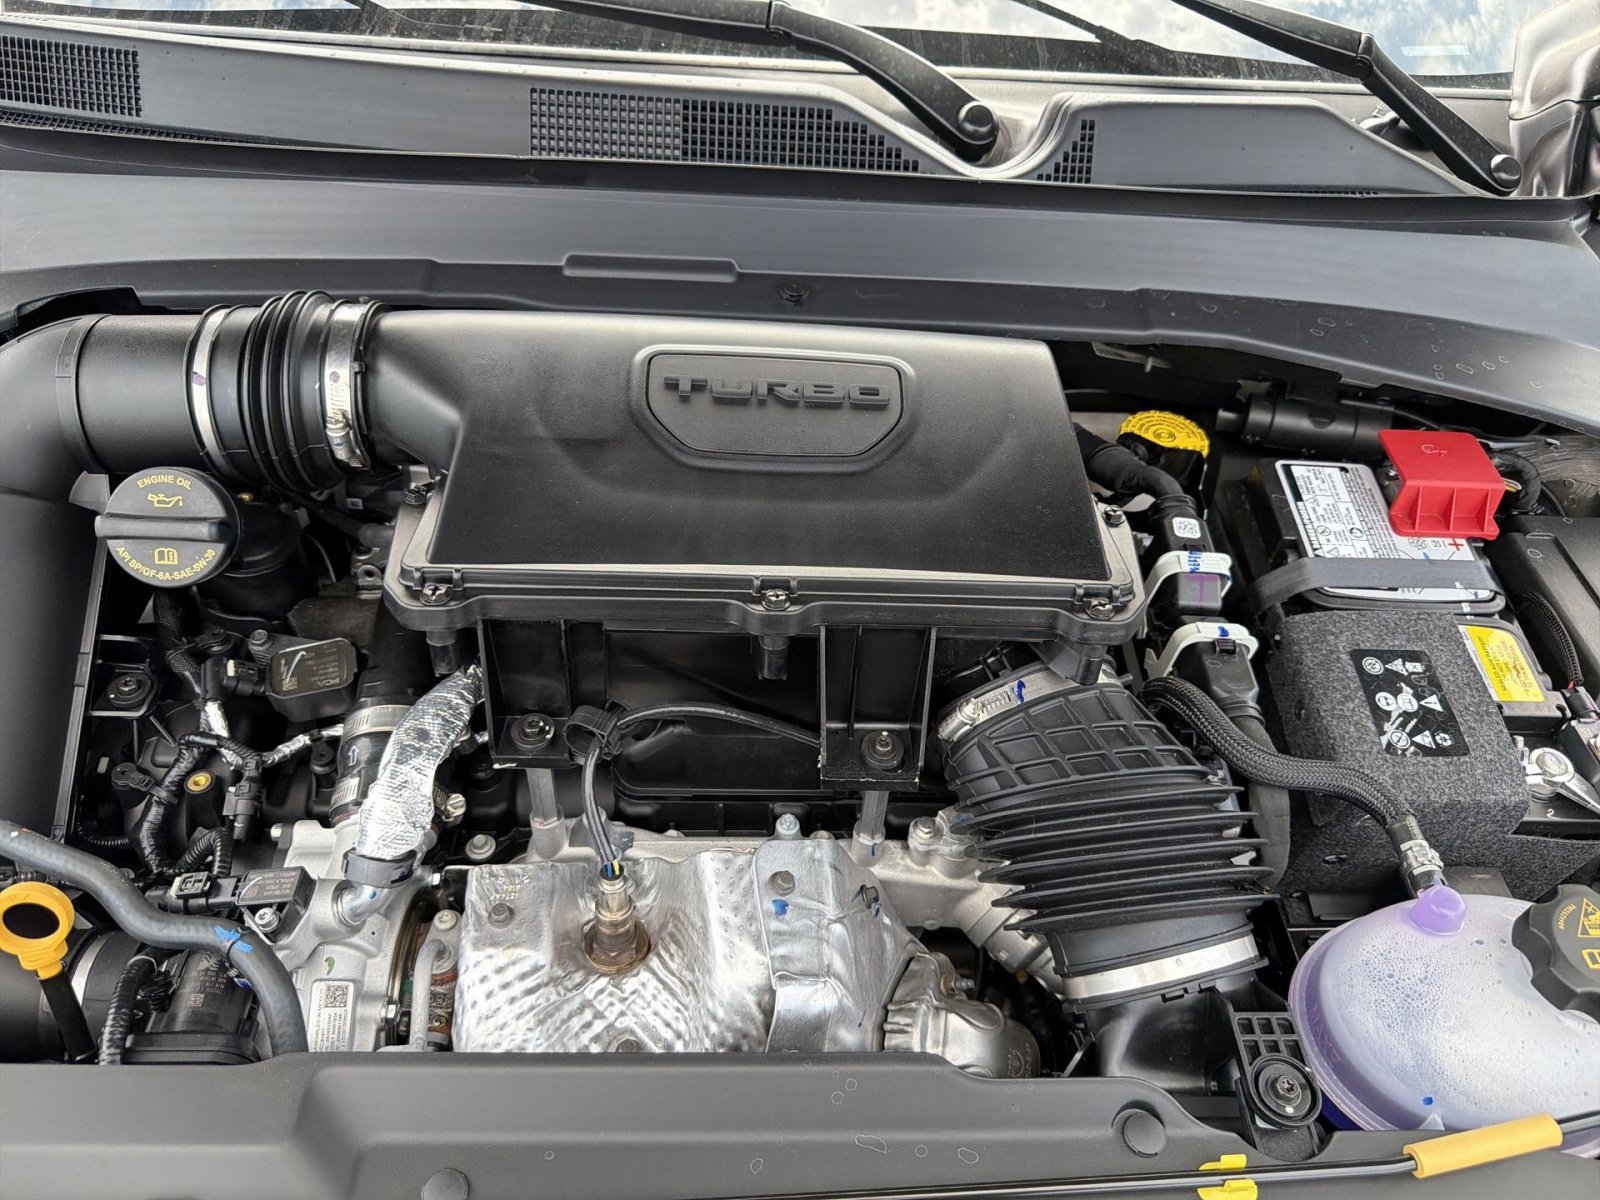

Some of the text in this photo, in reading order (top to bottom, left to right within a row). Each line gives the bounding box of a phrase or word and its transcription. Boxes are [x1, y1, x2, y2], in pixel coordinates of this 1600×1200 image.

[663, 374, 891, 406] TURBO
[137, 474, 192, 490] ENGINE OIL
[116, 546, 216, 581] API SP/GF-6A-SAE-5W-30
[1477, 636, 1491, 657] BATTERY
[1493, 670, 1508, 691] SEALED
